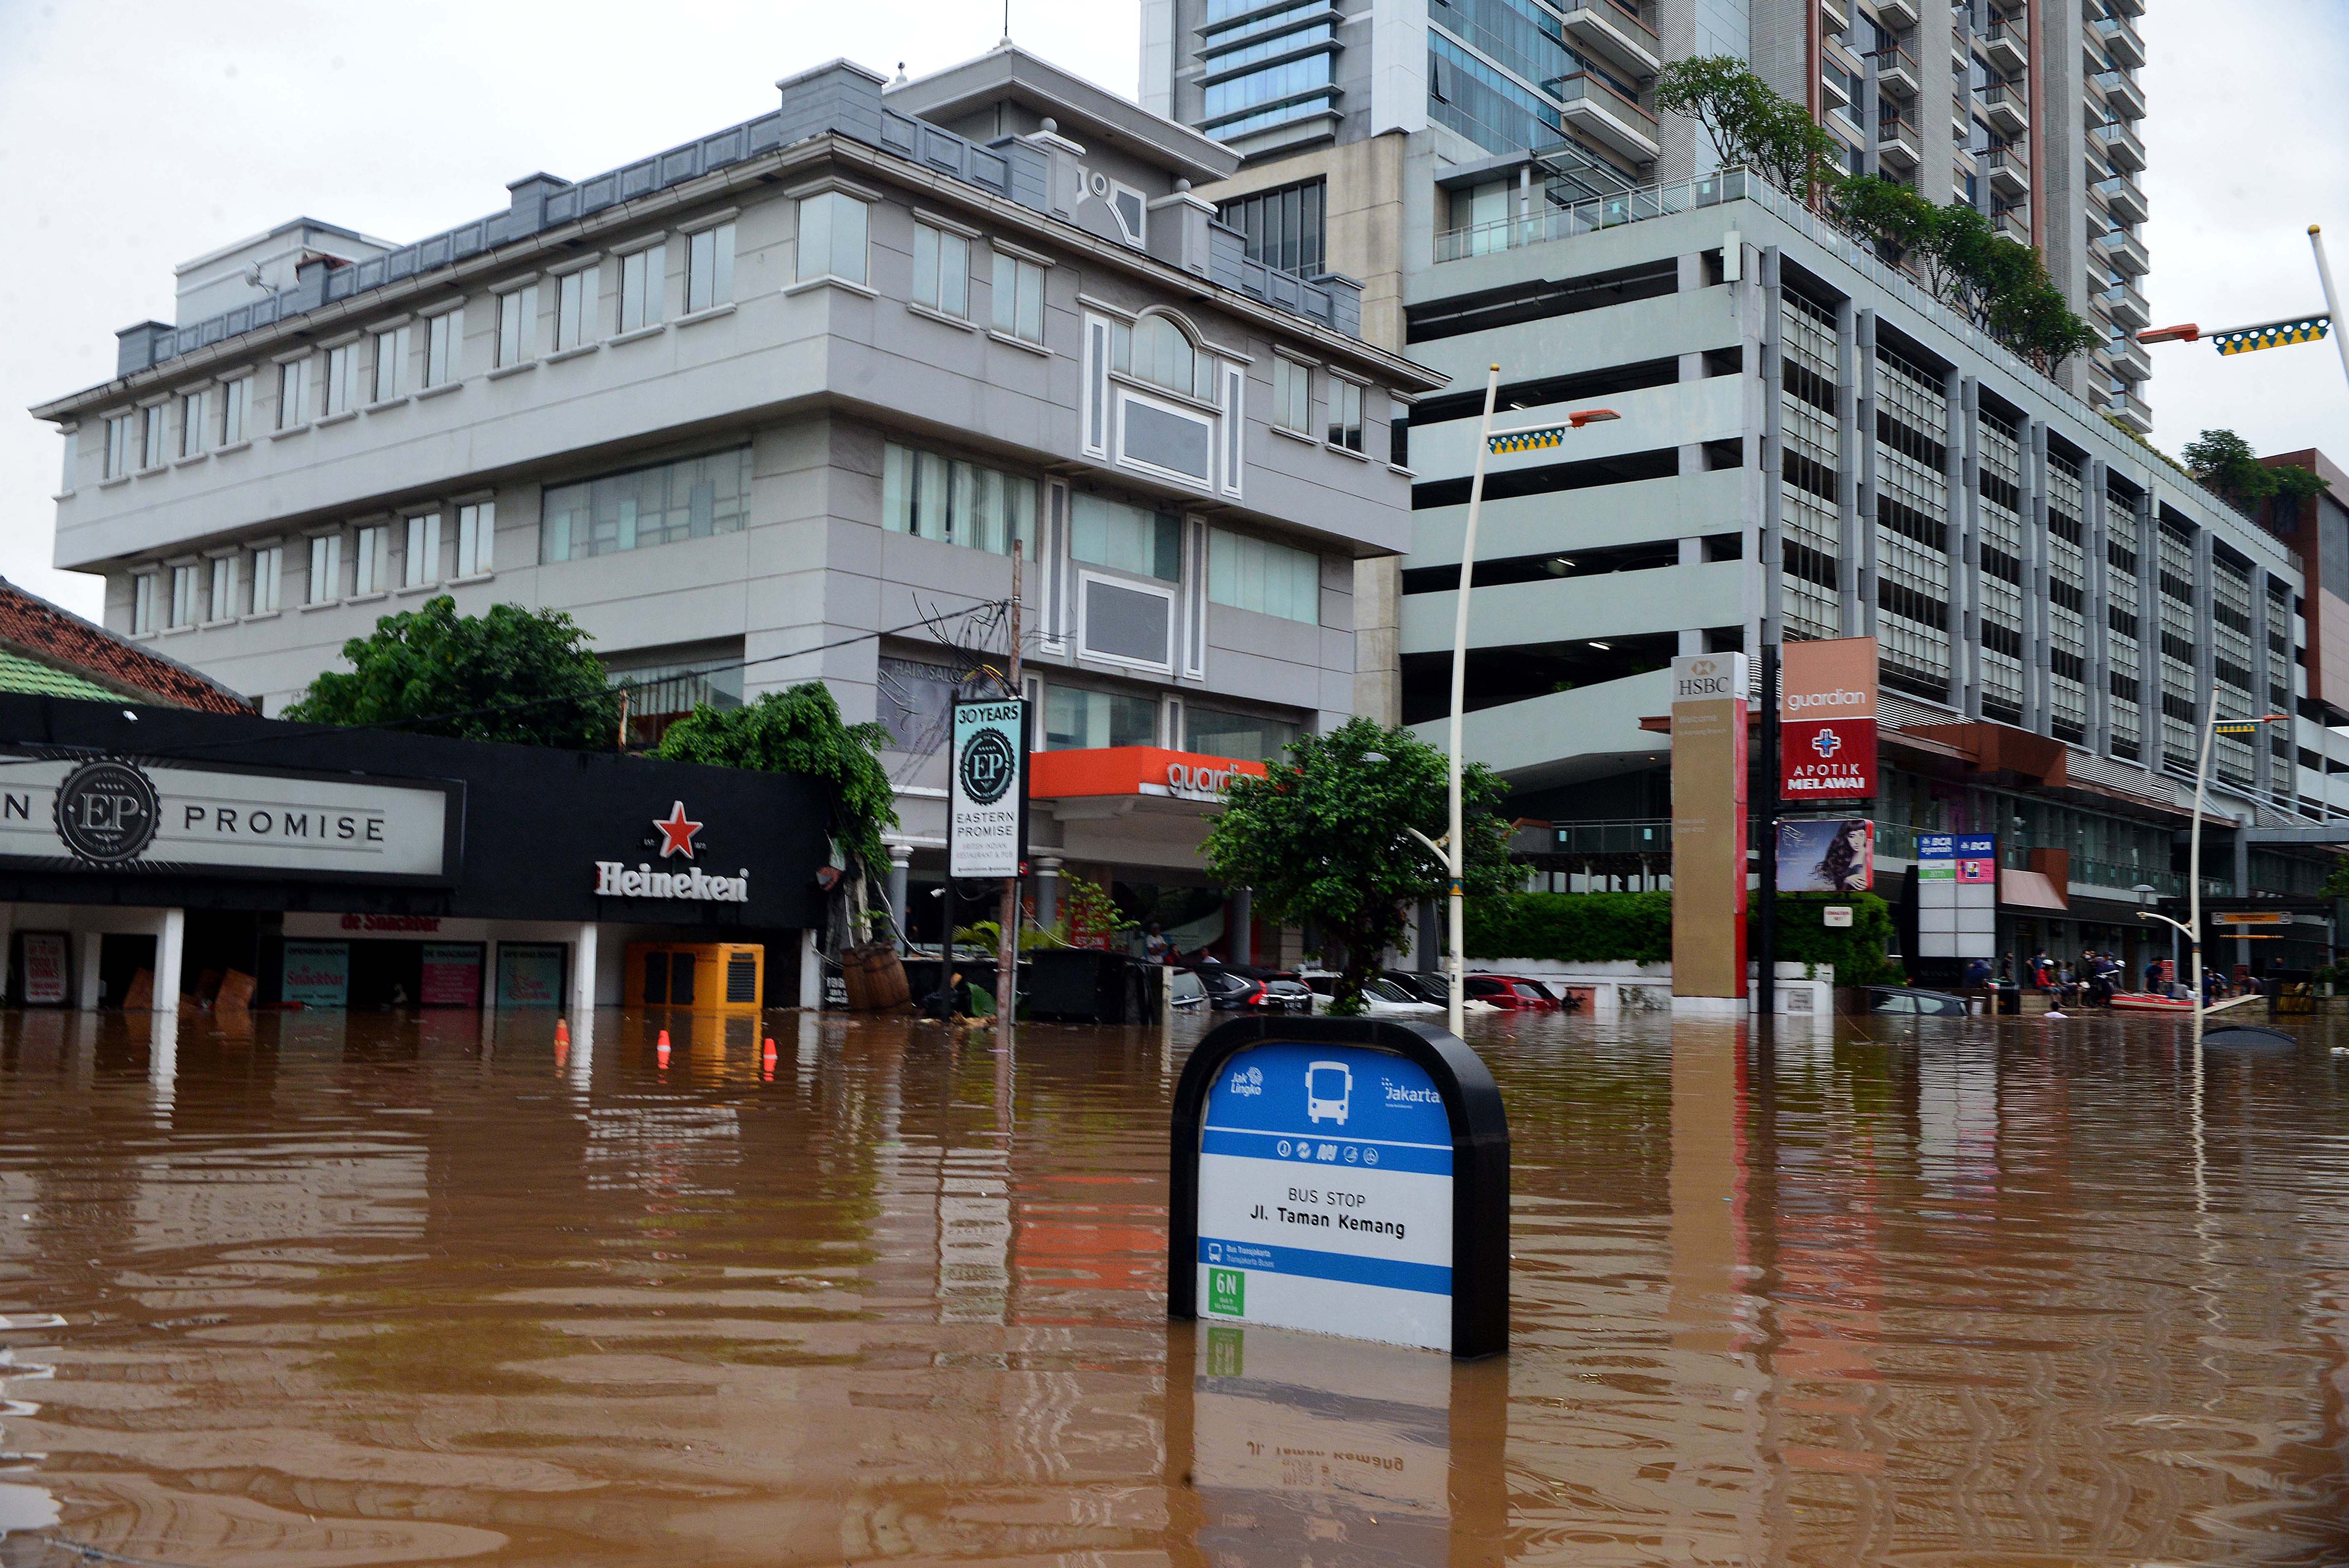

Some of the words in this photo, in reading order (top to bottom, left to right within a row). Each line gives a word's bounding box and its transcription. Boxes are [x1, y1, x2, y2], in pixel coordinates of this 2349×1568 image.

[894, 661, 924, 680] HAIR
[927, 666, 971, 685] SALO
[1679, 677, 1729, 696] HSBC
[1788, 688, 1866, 711] guardian
[973, 753, 1003, 780] EP
[1793, 763, 1860, 776] APOTIK
[1788, 777, 1865, 790] MELAWAI
[79, 793, 140, 832] EP
[956, 811, 1014, 824] EASTERN
[184, 805, 385, 842] PROMISE
[957, 825, 1013, 838] PROMISE
[1931, 837, 1952, 846] BCA
[1970, 842, 1991, 851] BCA
[593, 861, 750, 903] Heineken
[341, 913, 361, 930] de
[363, 914, 441, 932] Snackbar
[1385, 1085, 1441, 1104] Jakarta
[1288, 1188, 1318, 1203] BUS
[1326, 1191, 1366, 1208] STOP
[1250, 1204, 1268, 1220] Jl.
[1277, 1207, 1330, 1227] Taman
[1338, 1213, 1405, 1240] Kemang
[1226, 1244, 1237, 1253] Bus
[1238, 1246, 1271, 1258] Transjakarta
[1216, 1273, 1237, 1296] 6N
